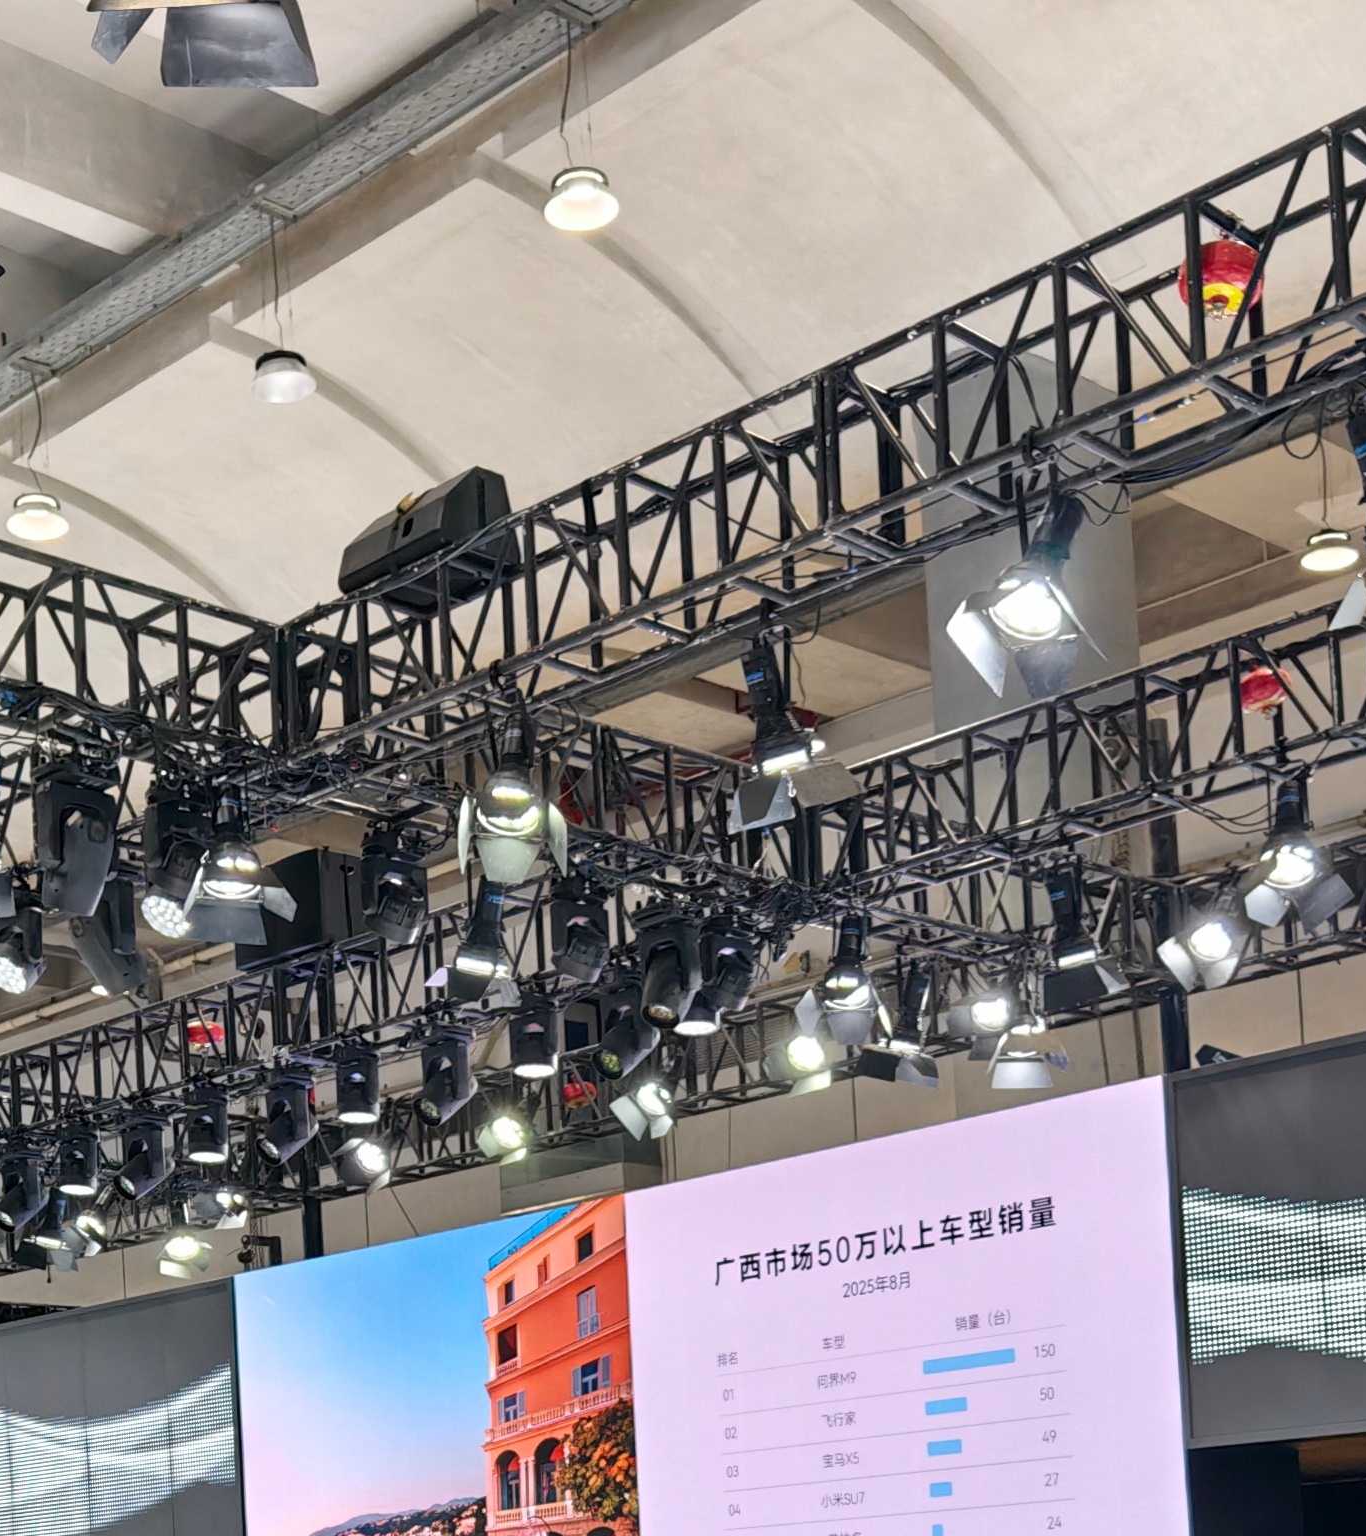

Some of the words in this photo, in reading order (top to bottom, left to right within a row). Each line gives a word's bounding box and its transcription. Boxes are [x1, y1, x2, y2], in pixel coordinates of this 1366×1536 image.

[714, 1196, 1057, 1287] 广西市场50万以上车型销量
[842, 1271, 912, 1299] 2025年8月
[717, 1351, 739, 1368] 排名
[822, 1335, 845, 1351] 车型
[723, 1388, 735, 1401] 01
[817, 1371, 857, 1390] 问界M9
[1034, 1343, 1056, 1359] 150
[724, 1426, 738, 1440] 02
[821, 1411, 857, 1428] 飞行家
[1040, 1386, 1055, 1401] 50
[726, 1465, 739, 1478] 03
[822, 1452, 860, 1469] 宝马X5
[1041, 1429, 1057, 1443] 49
[728, 1503, 741, 1516] 04
[821, 1491, 866, 1509] 小米SU7
[1044, 1472, 1060, 1487] 27
[1047, 1516, 1062, 1530] 24
